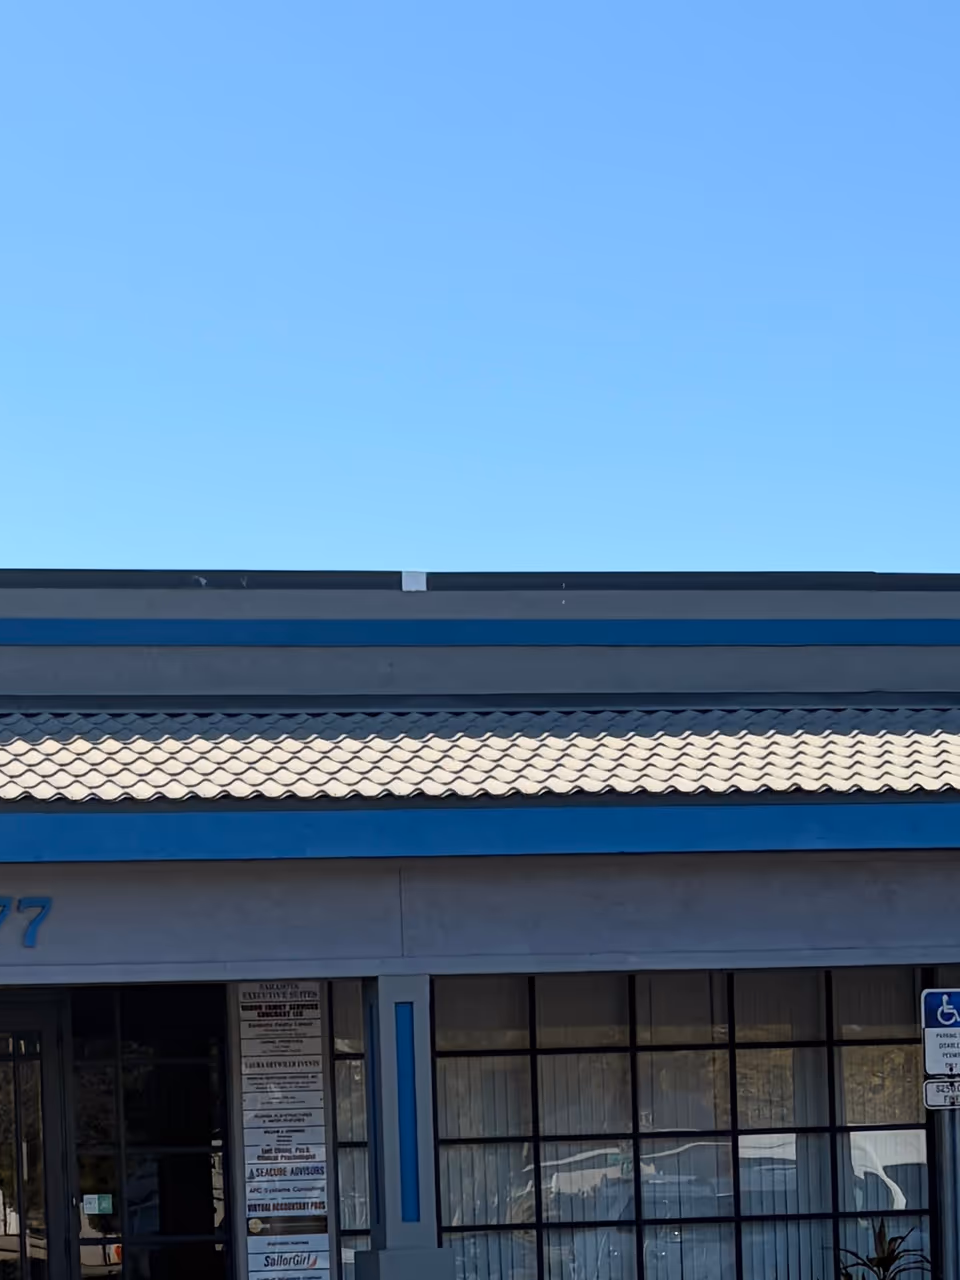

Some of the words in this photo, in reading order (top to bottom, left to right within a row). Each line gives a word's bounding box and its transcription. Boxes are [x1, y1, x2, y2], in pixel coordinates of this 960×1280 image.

[242, 991, 288, 999] EXECUTIVE
[289, 991, 318, 999] SUITES
[290, 1166, 325, 1176] ADVISORS
[248, 1203, 271, 1212] VIRTUAL
[272, 1201, 309, 1211] ACCOUNTANT
[264, 1254, 310, 1267] SailorGirl
